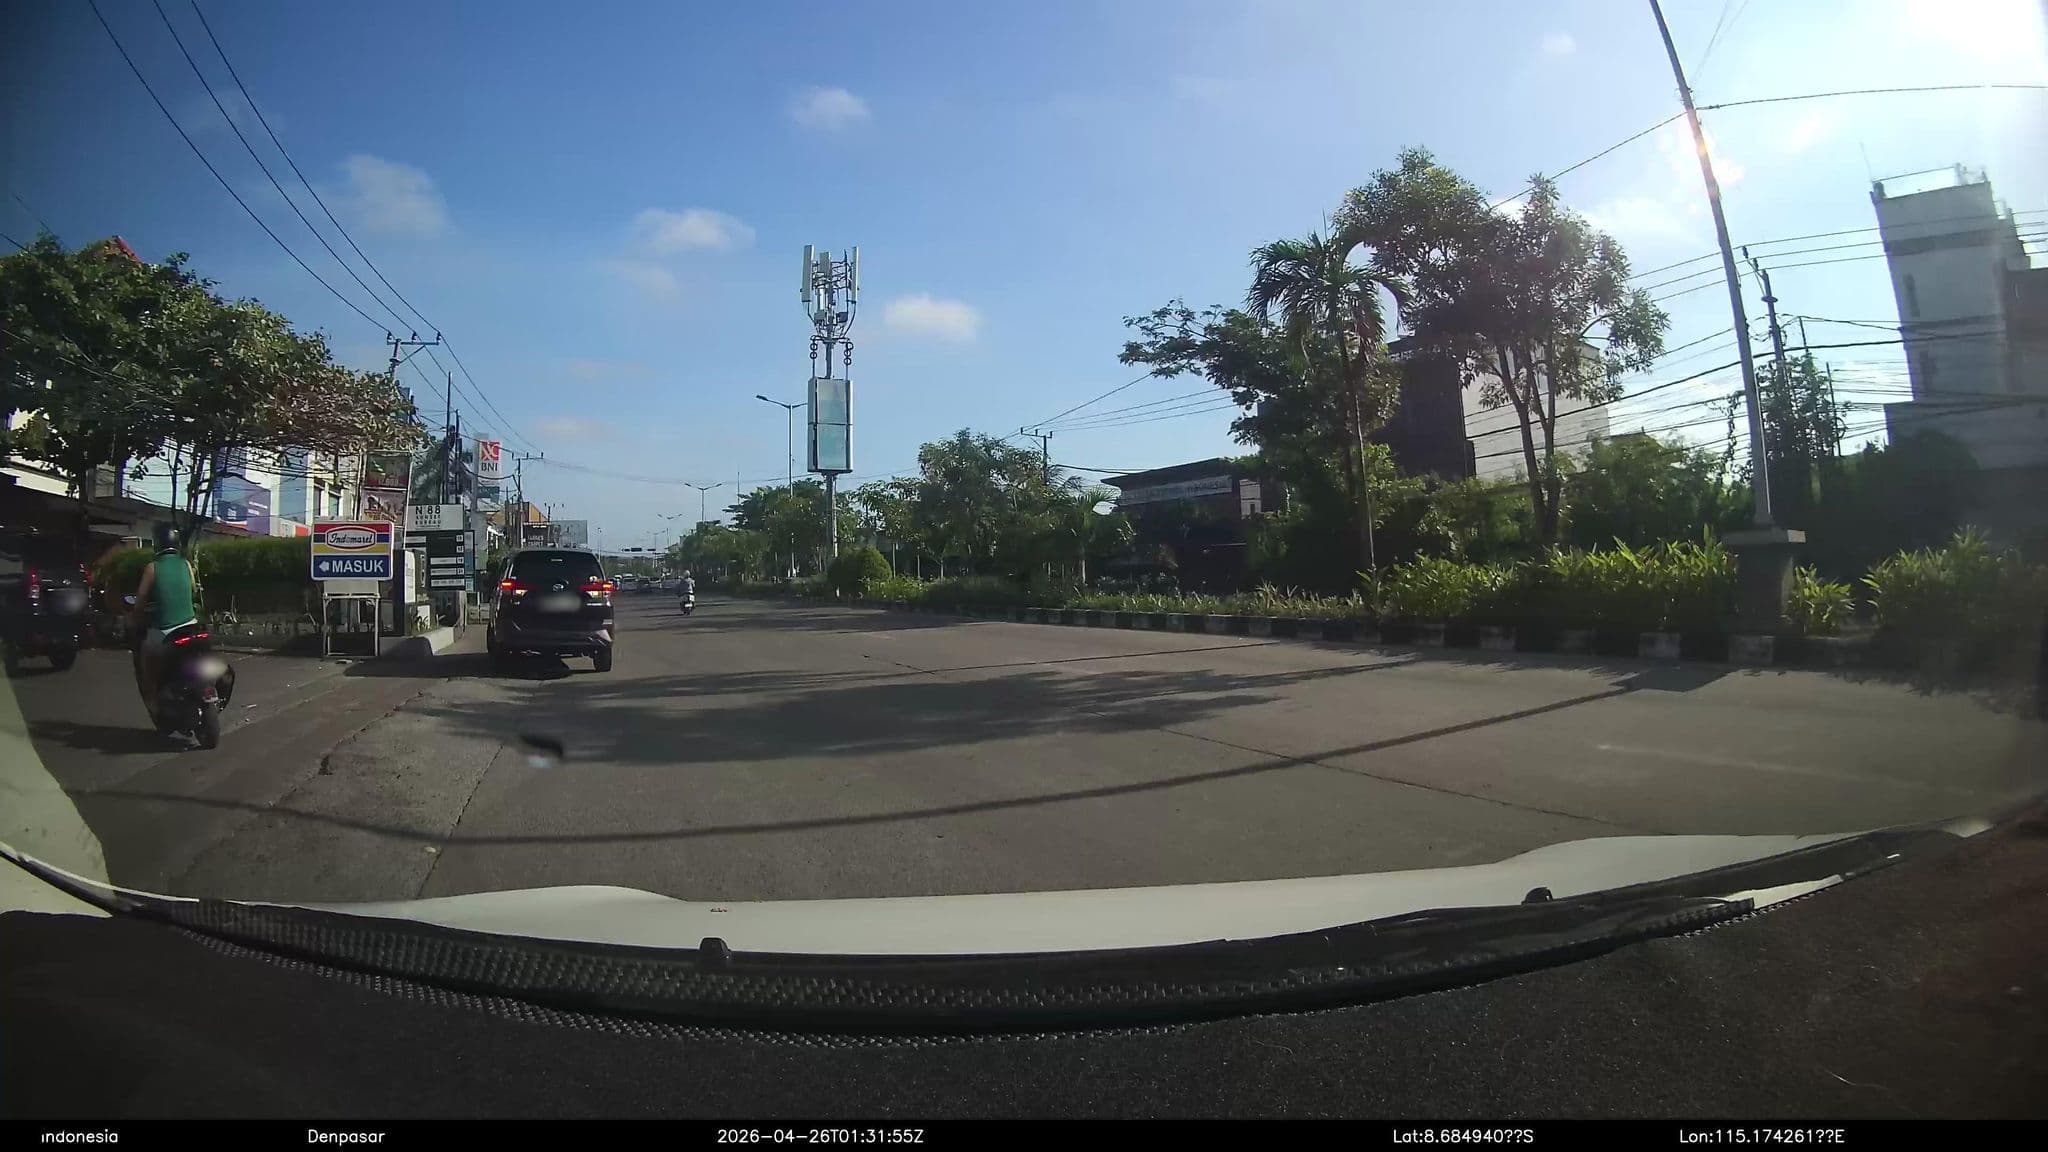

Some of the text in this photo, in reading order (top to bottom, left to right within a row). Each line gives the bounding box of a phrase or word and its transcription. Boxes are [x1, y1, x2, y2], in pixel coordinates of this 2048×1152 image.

[481, 462, 498, 472] BNI
[427, 505, 441, 515] 88
[329, 532, 374, 544] Indomaret
[332, 559, 384, 574] MASUK
